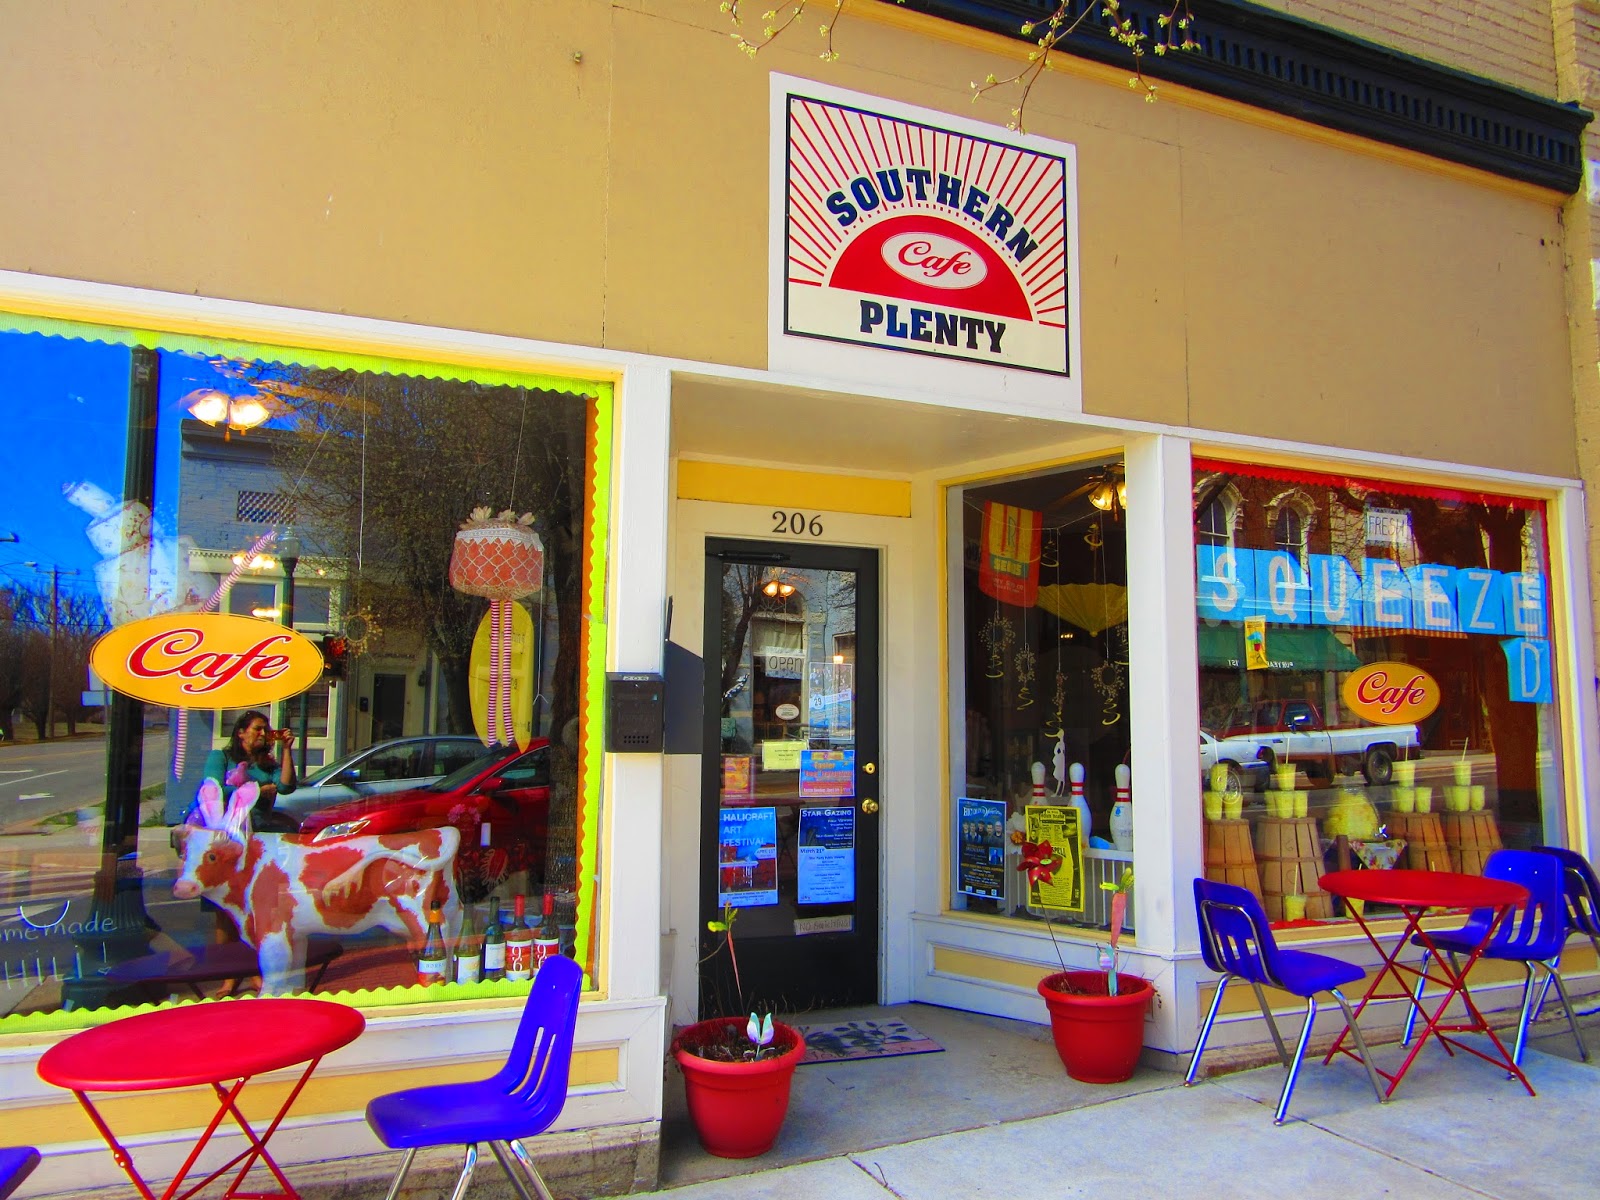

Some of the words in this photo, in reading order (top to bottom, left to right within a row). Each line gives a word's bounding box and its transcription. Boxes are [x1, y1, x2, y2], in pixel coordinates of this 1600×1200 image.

[825, 167, 1039, 264] SOUTHERN
[897, 240, 972, 278] Cafe
[860, 299, 1007, 354] PLENTY
[771, 510, 823, 537] 206
[1368, 515, 1405, 537] FRESH
[126, 628, 292, 694] Cafe
[1356, 671, 1427, 715] Cafe
[723, 825, 743, 834] ART
[723, 837, 766, 847] FESTIVAL
